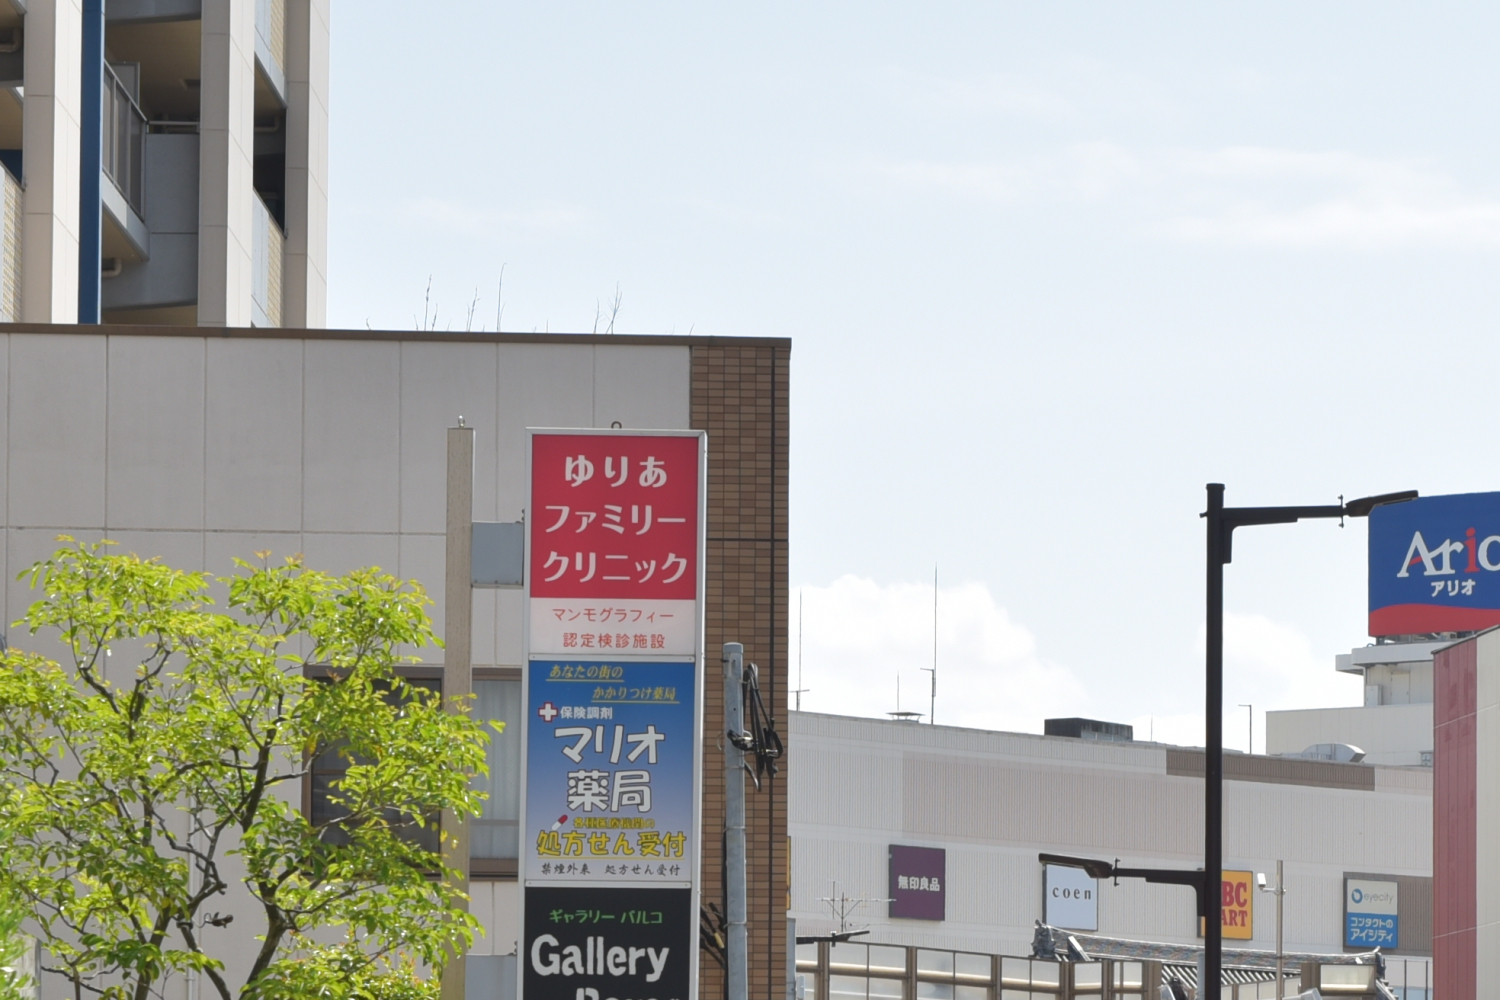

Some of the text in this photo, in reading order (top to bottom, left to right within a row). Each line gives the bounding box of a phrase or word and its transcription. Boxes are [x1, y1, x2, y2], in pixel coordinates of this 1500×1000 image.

[564, 454, 668, 488] ゆりあ
[545, 504, 686, 536] ファミリー
[543, 551, 688, 584] クリニック
[1431, 578, 1476, 598] アリオ
[552, 606, 674, 623] マンモグラフィー
[563, 632, 666, 649] 認定検診施設
[550, 664, 624, 679] あなたの街の
[592, 686, 676, 701] かかりつけ薬局
[560, 705, 613, 720] 保険調剤
[554, 724, 666, 765] マリオ
[567, 769, 652, 813] 薬局
[573, 816, 656, 829] 各種医療機関の
[536, 829, 687, 858] 処方せん受付
[540, 864, 682, 877] 禁煙外来 処方せん受付
[898, 875, 940, 892] 無印良品
[1052, 885, 1093, 900] coen
[1222, 881, 1248, 908] BC
[1364, 892, 1394, 904] eyecity
[549, 909, 663, 924] ギャラリー バルコ
[1222, 908, 1248, 928] ART
[1351, 917, 1394, 929] コンタクトの
[1351, 928, 1394, 942] アイシティ
[531, 933, 670, 983] Gallery
